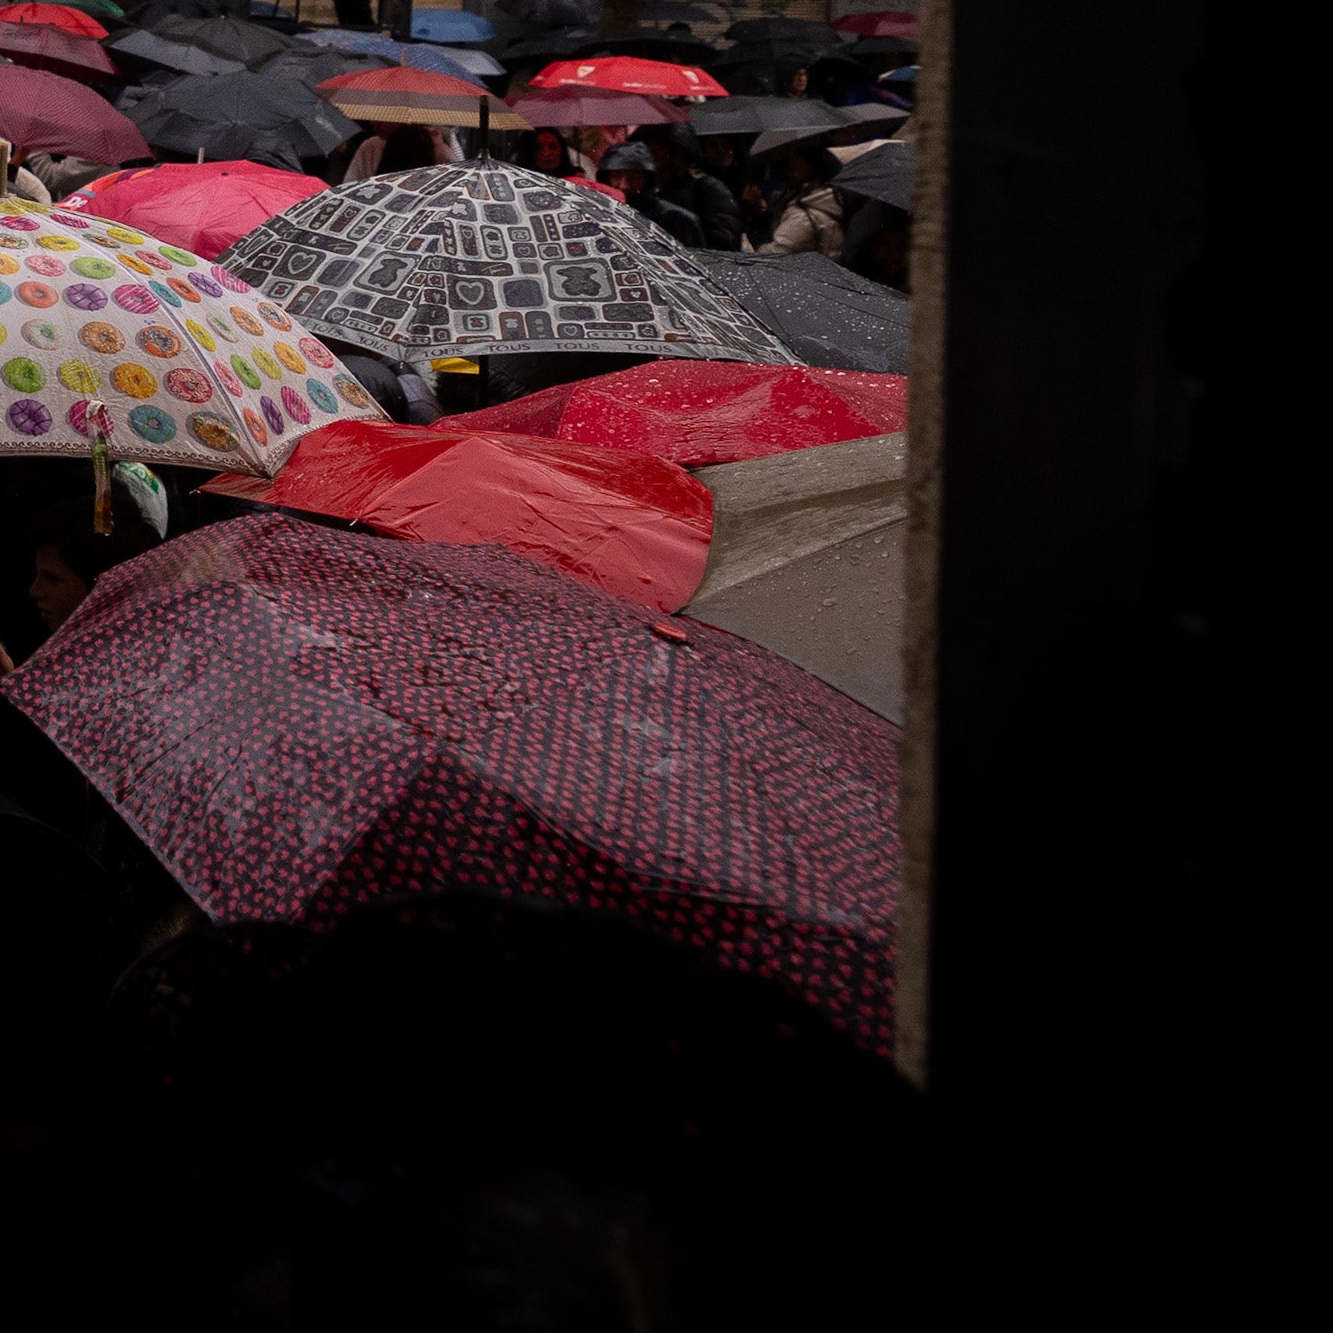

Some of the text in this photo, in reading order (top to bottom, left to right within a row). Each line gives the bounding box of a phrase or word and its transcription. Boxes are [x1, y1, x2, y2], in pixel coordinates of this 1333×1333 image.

[312, 323, 344, 337] TOUS
[358, 336, 390, 351] TOUS
[422, 347, 464, 357] TOUS
[486, 342, 531, 352] TOUS
[554, 340, 600, 351] TOUS
[625, 342, 673, 353] TOUS
